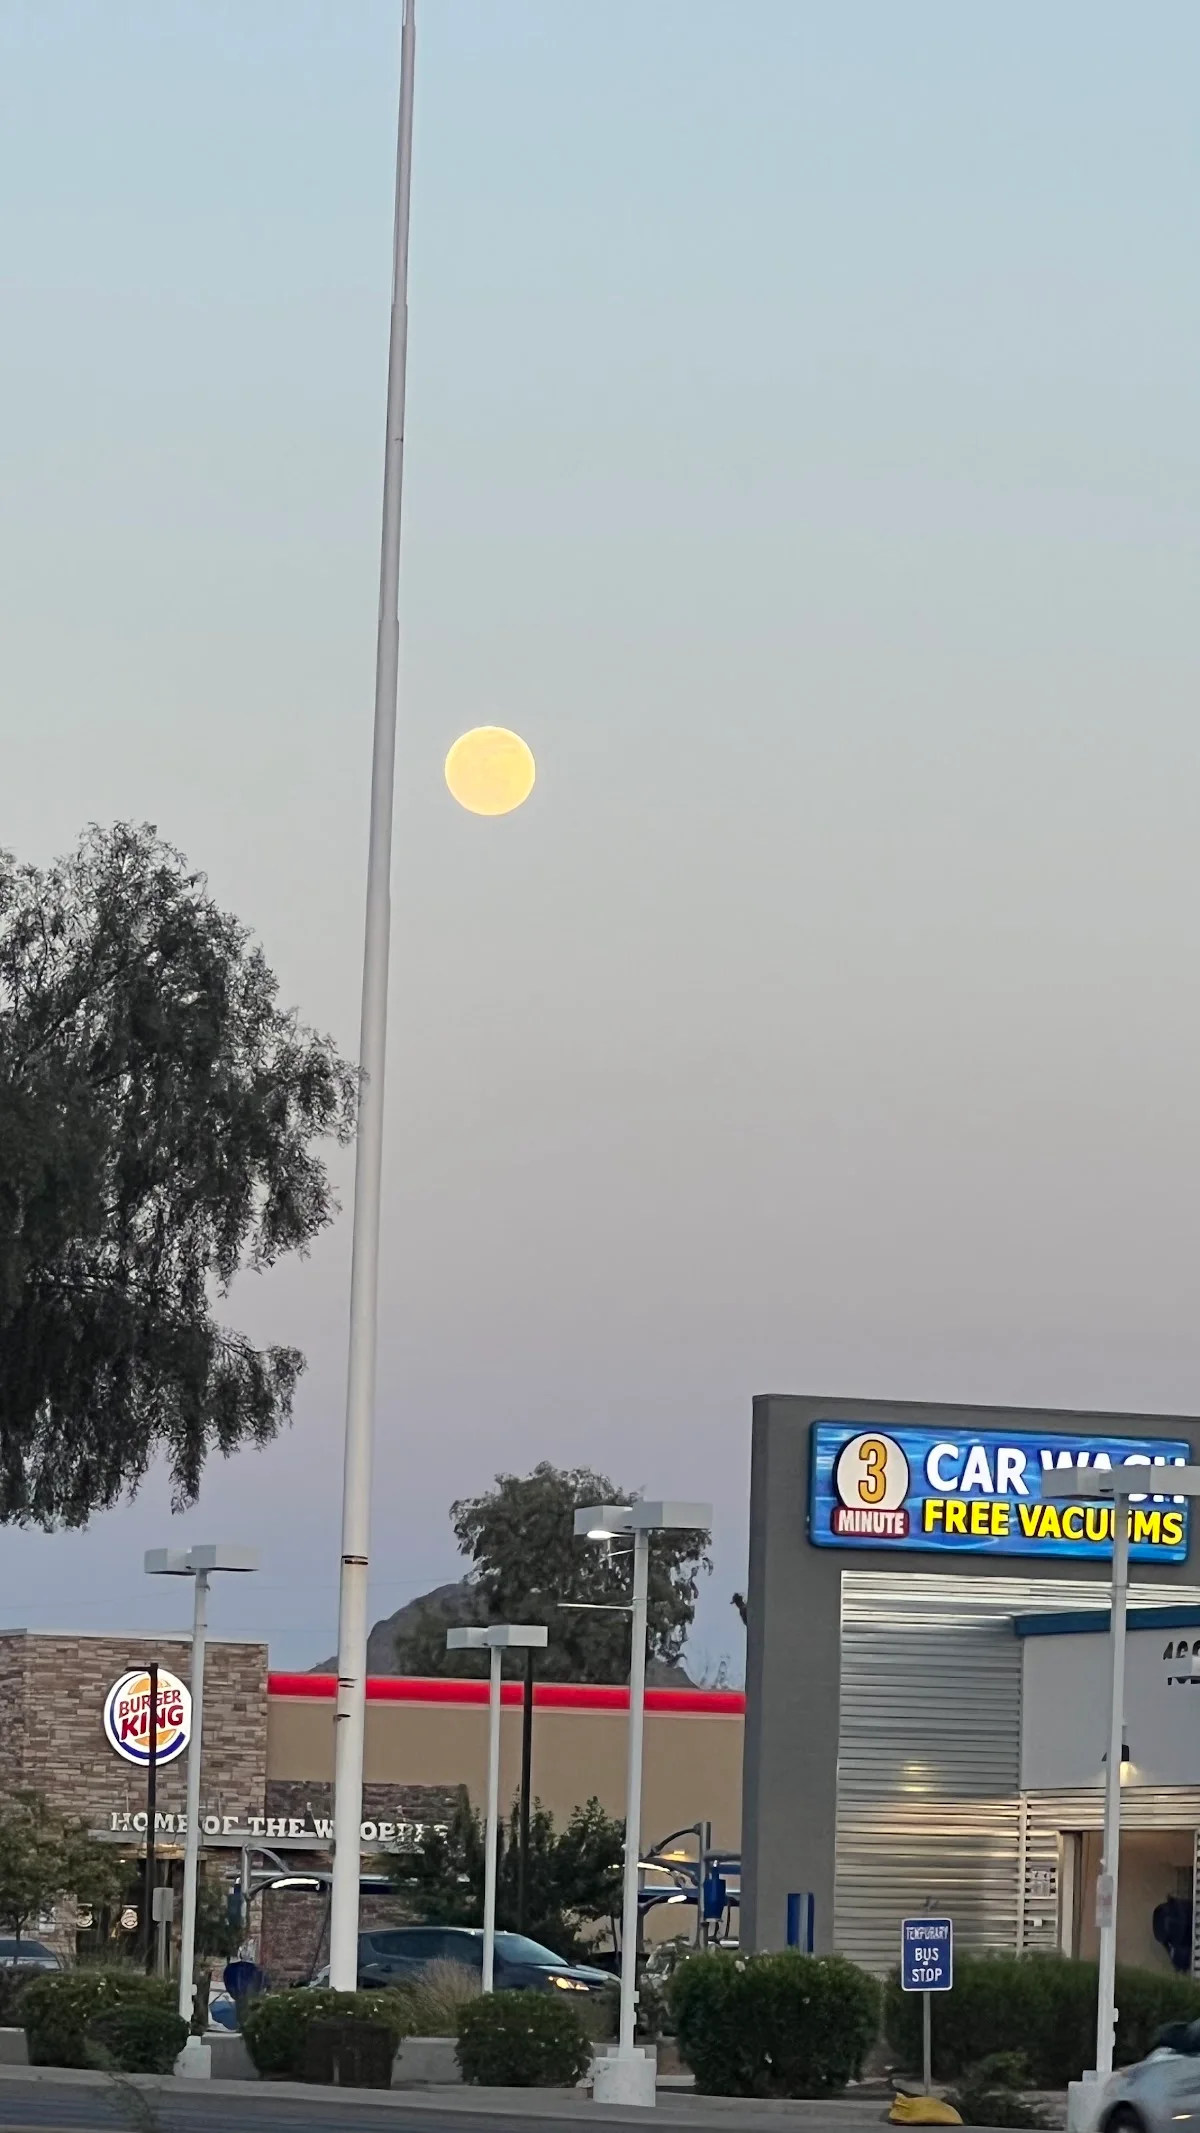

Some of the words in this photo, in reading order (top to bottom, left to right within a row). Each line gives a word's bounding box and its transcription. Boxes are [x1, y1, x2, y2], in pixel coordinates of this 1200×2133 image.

[858, 1439, 888, 1504] 3
[926, 1443, 1030, 1495] CAR
[838, 1509, 905, 1535] MINUTE
[924, 1499, 1010, 1536] FREE
[118, 1689, 182, 1719] BURGER
[120, 1704, 184, 1741] KING
[110, 1811, 188, 1834] HOME
[203, 1815, 239, 1836] OF
[248, 1816, 305, 1838] THE
[915, 1947, 939, 1962] BUS
[911, 1967, 943, 1983] STOP
